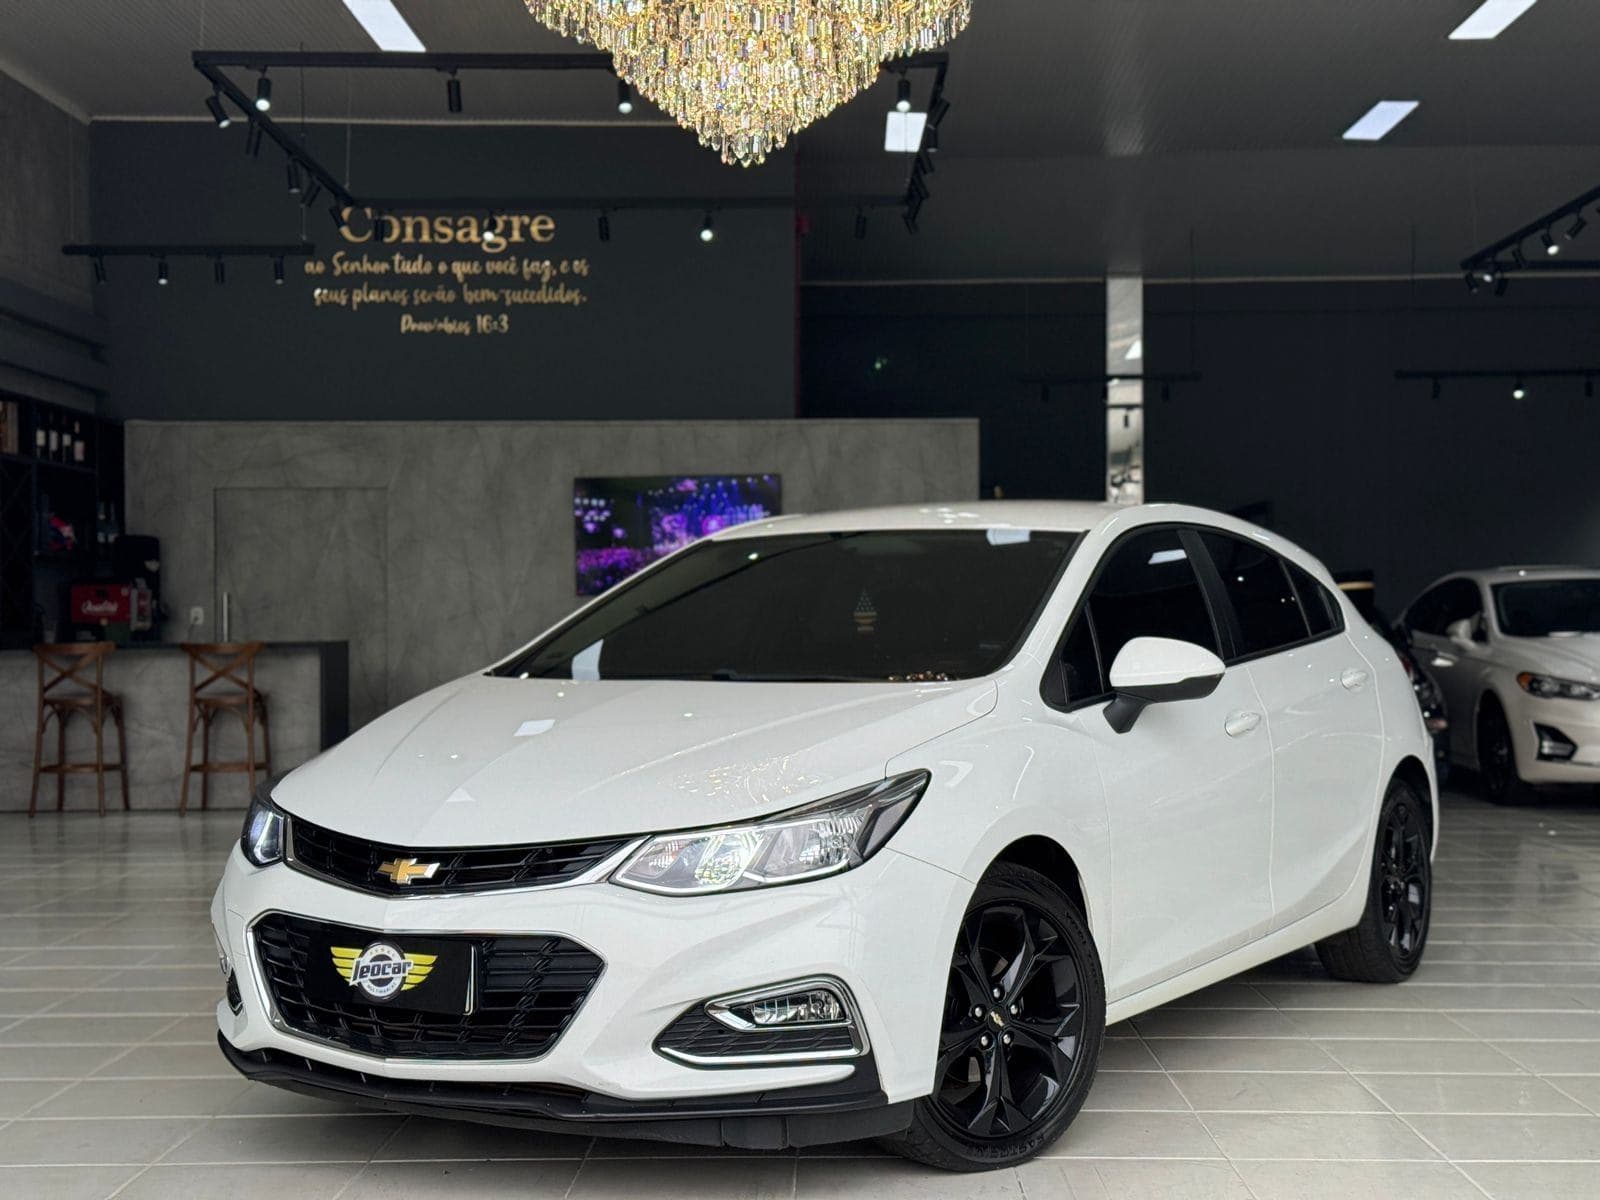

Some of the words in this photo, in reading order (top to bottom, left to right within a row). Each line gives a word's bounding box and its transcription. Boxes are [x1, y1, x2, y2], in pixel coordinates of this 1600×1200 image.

[339, 206, 555, 253] Consagre
[304, 260, 325, 274] ao
[332, 251, 390, 276] Senhor
[392, 252, 432, 274] tudo
[438, 261, 448, 274] o
[451, 260, 481, 282] que
[485, 256, 518, 275] você
[560, 259, 569, 274] e
[573, 259, 589, 276] os
[313, 287, 348, 306] seus
[351, 281, 408, 311] planos
[413, 284, 456, 305] serão
[476, 313, 509, 334] 16:3
